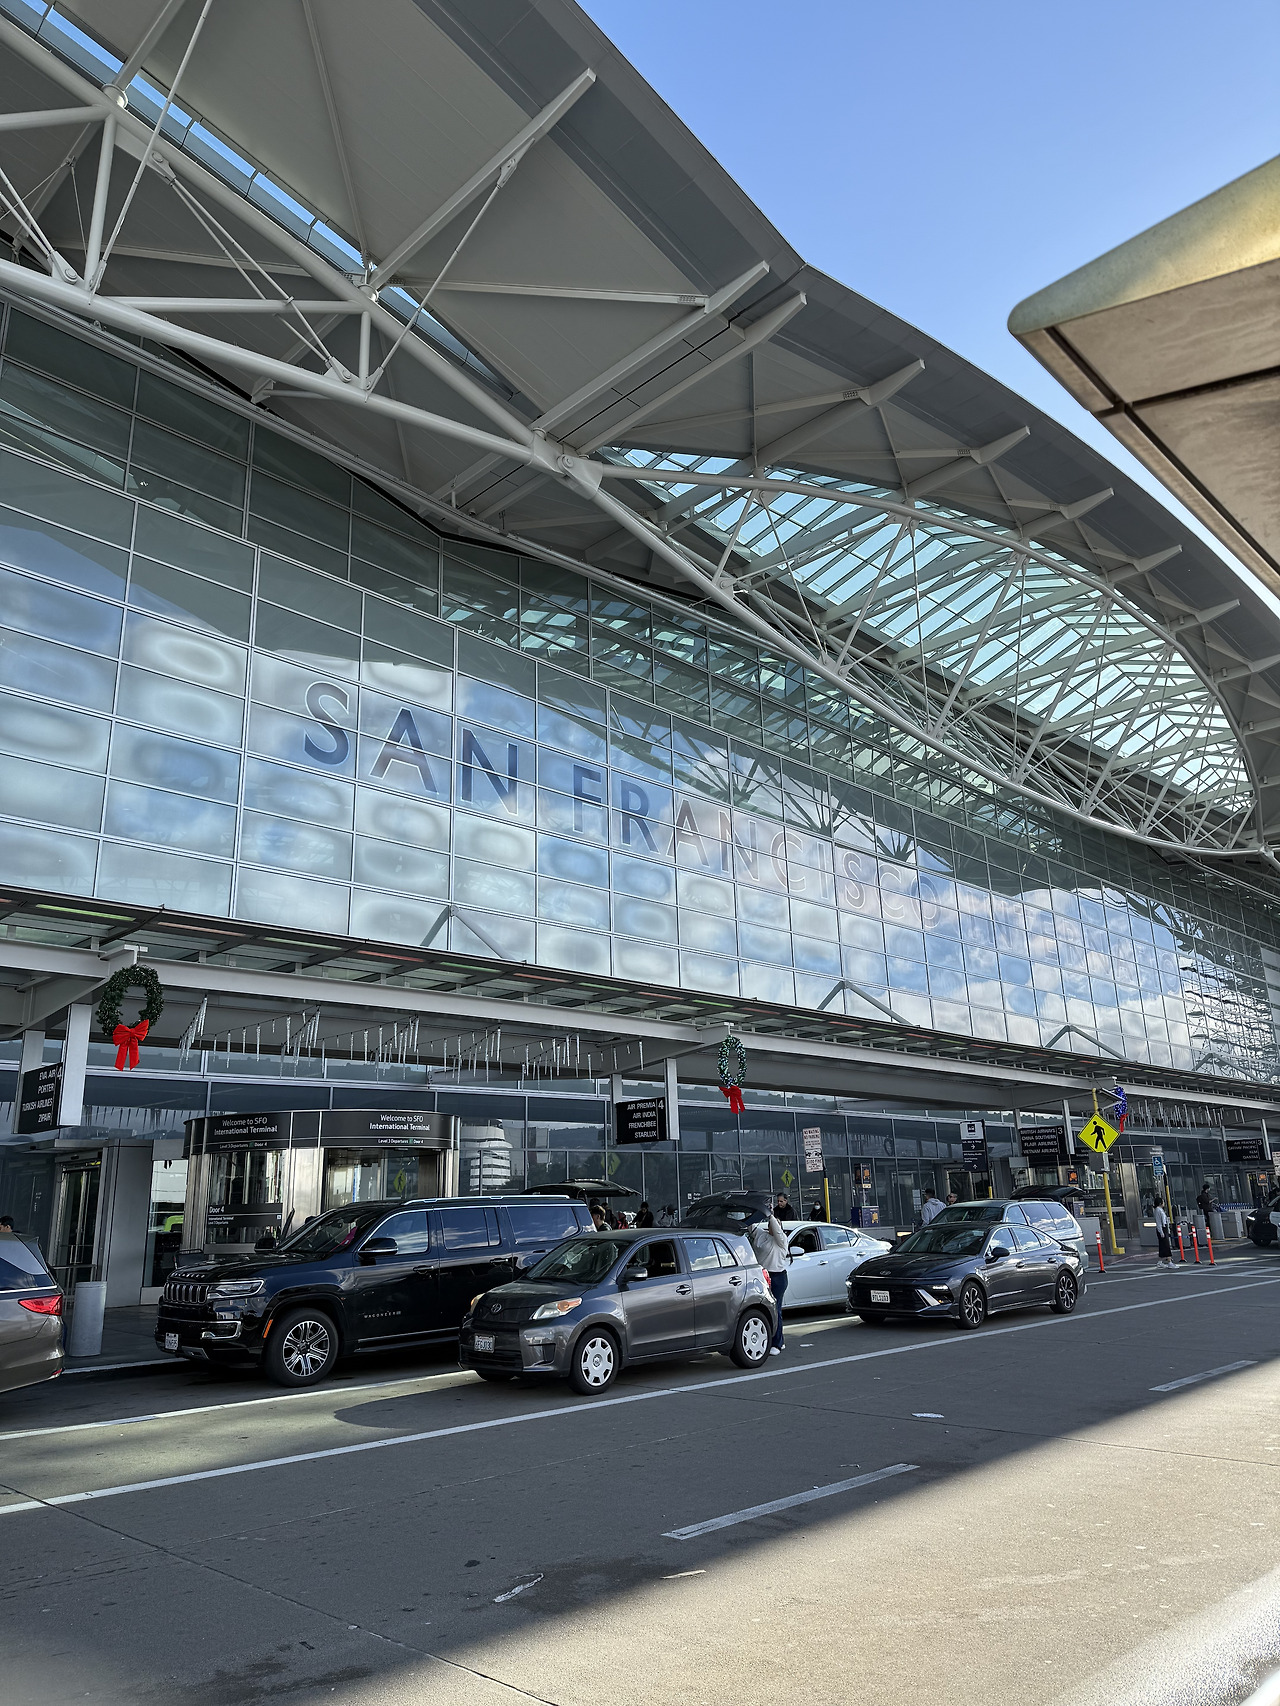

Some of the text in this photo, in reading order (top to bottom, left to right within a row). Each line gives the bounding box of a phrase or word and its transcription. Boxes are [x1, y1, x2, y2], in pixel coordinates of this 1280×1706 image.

[304, 681, 518, 817] SAN
[572, 763, 941, 929] FRANCISCO
[57, 1066, 62, 1081] 4
[38, 1083, 54, 1094] PORTER
[37, 1098, 53, 1109] AIRLINES
[658, 1100, 664, 1110] 4
[222, 1116, 268, 1127] Welcome to SFO
[380, 1114, 406, 1122] Welcome
[413, 1115, 424, 1123] SFO
[214, 1124, 278, 1135] International Terminal
[409, 1123, 430, 1131] Terminal
[629, 1121, 656, 1129] FRENCHBEE
[209, 1205, 225, 1214] Door 4
